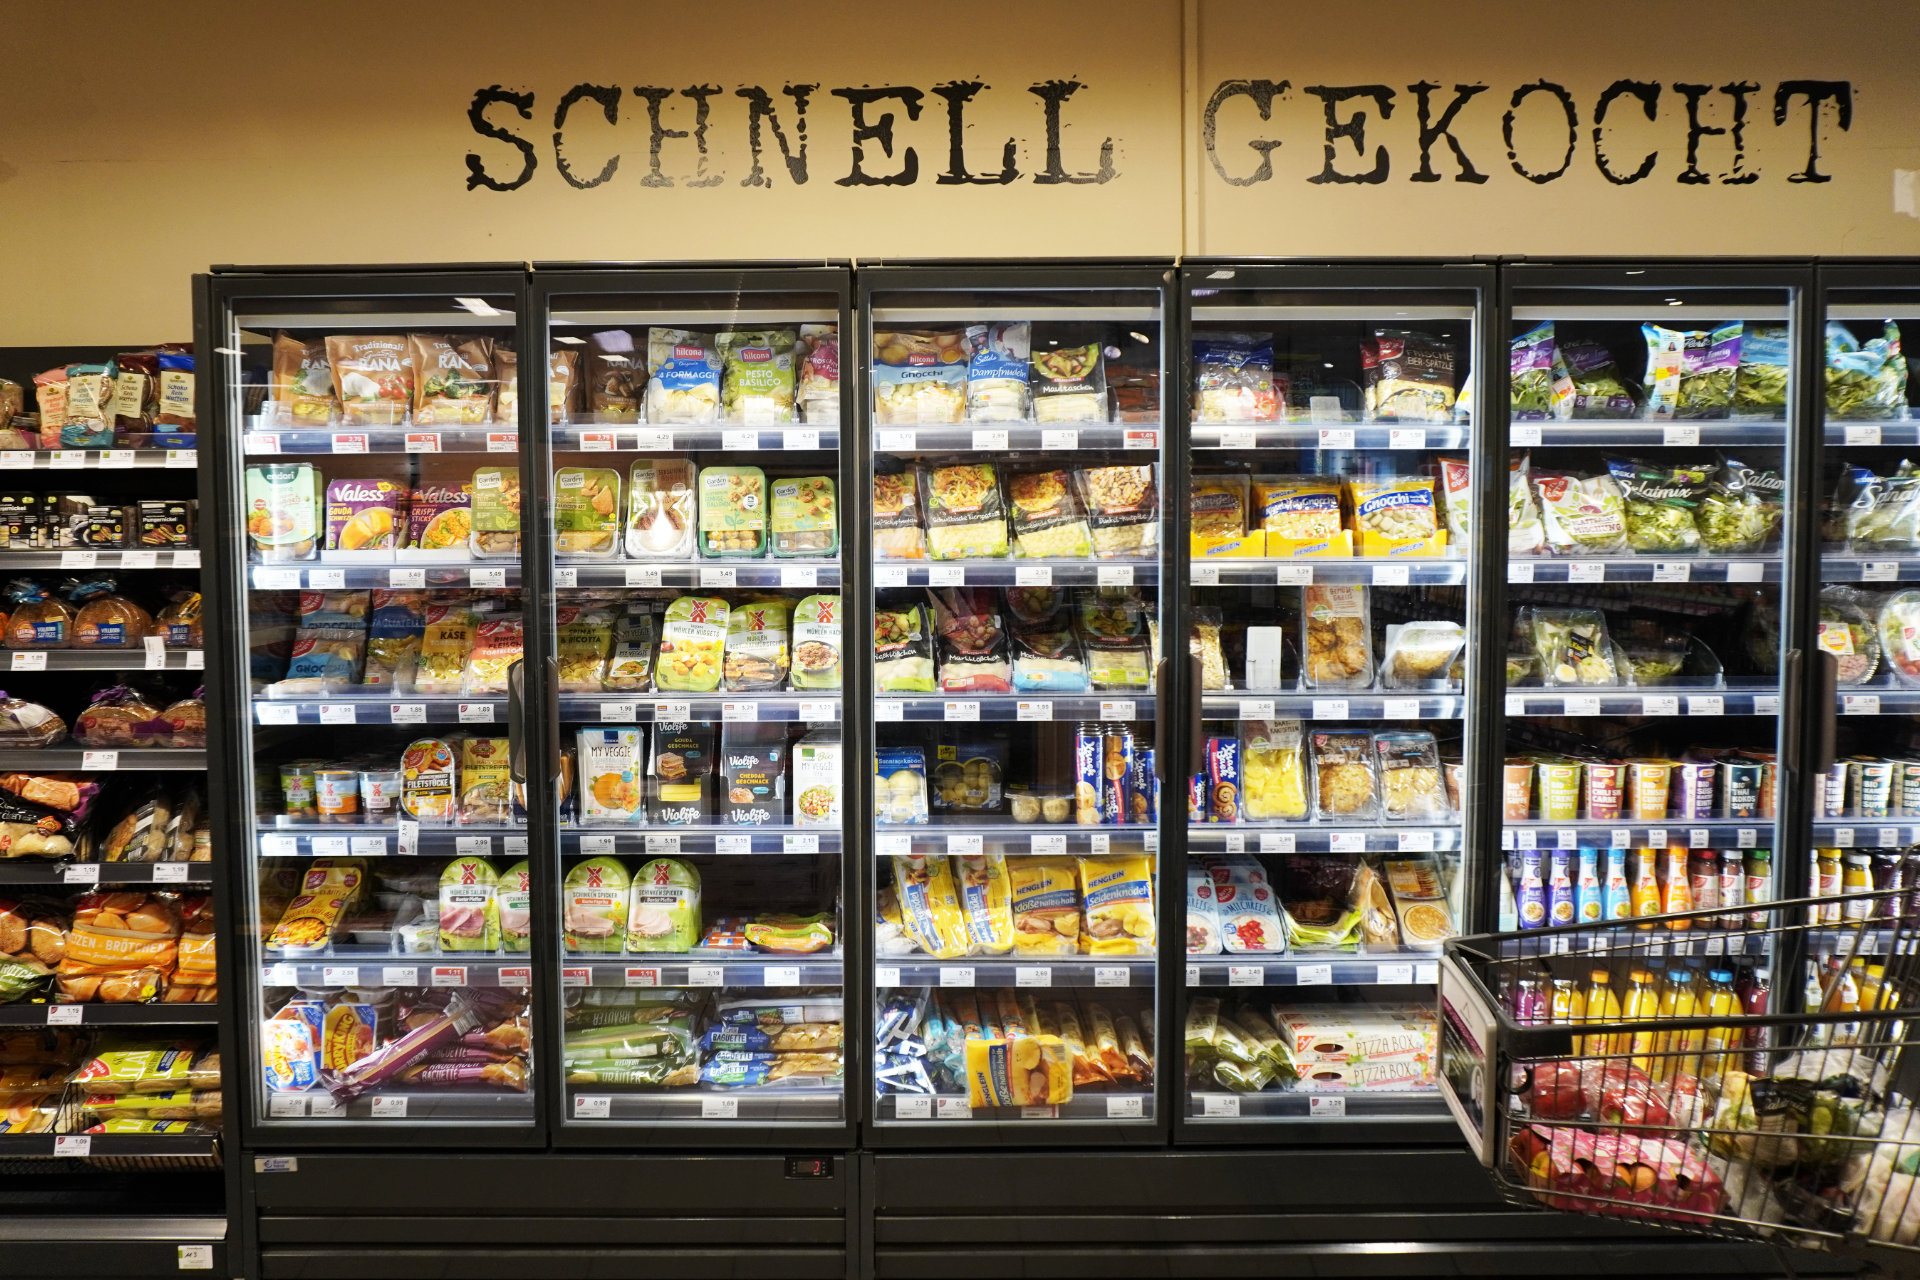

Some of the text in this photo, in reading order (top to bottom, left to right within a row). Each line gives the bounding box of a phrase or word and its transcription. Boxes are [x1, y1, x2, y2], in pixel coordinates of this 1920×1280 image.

[466, 76, 1855, 191] SCHNELL GEKOCHT
[352, 340, 404, 352] Tradizionali
[676, 345, 702, 356] hilcona
[743, 350, 770, 360] hilcona
[909, 355, 936, 364] hilcona
[359, 358, 402, 371] RANA
[666, 371, 715, 379] FORMAGGI
[745, 370, 773, 378] PESTO
[901, 370, 943, 379] Gnocchi
[971, 366, 1026, 379] Dampfnudeln
[739, 378, 781, 387] BASILICO
[1042, 384, 1094, 393] Maultaschen
[478, 475, 500, 484] Garden
[561, 475, 583, 483] Garden
[635, 470, 655, 478] Garden
[706, 476, 727, 485] Garden
[334, 484, 384, 502] Valess
[418, 486, 468, 504] Valess
[776, 487, 796, 495] Garden
[1363, 494, 1410, 512] Gnocchi
[329, 507, 352, 516] GOUDA
[412, 508, 436, 516] CRISPY
[1207, 542, 1241, 555] HENGLEIN
[1294, 542, 1329, 556] HENGLEIN
[1390, 542, 1424, 555] HENGLEIN
[440, 629, 467, 640] KÄSE
[658, 721, 688, 735] Violife
[591, 746, 632, 758] MY VEGGIE
[816, 752, 834, 761] Bio
[729, 755, 759, 769] Violife
[1224, 743, 1236, 779] Knack
[407, 777, 448, 788] FILETSTÜCKE
[662, 807, 700, 825] Violife
[731, 807, 770, 826] Violife
[1088, 870, 1125, 888] HENGLEIN
[638, 889, 684, 897] SCHINKEN SPICKER
[1016, 879, 1052, 895] HENGLEIN
[1089, 885, 1147, 905] Seidenknödel
[1014, 898, 1039, 913] Klöße
[1227, 900, 1267, 913] MILCHREIS
[105, 937, 167, 953] BRÖTCHEN
[712, 1033, 746, 1043] BAGUETTE
[1356, 1035, 1416, 1055] PIZZA BOX
[422, 1069, 458, 1081] BAGUETTE
[1354, 1063, 1414, 1084] PIZZA BOX
